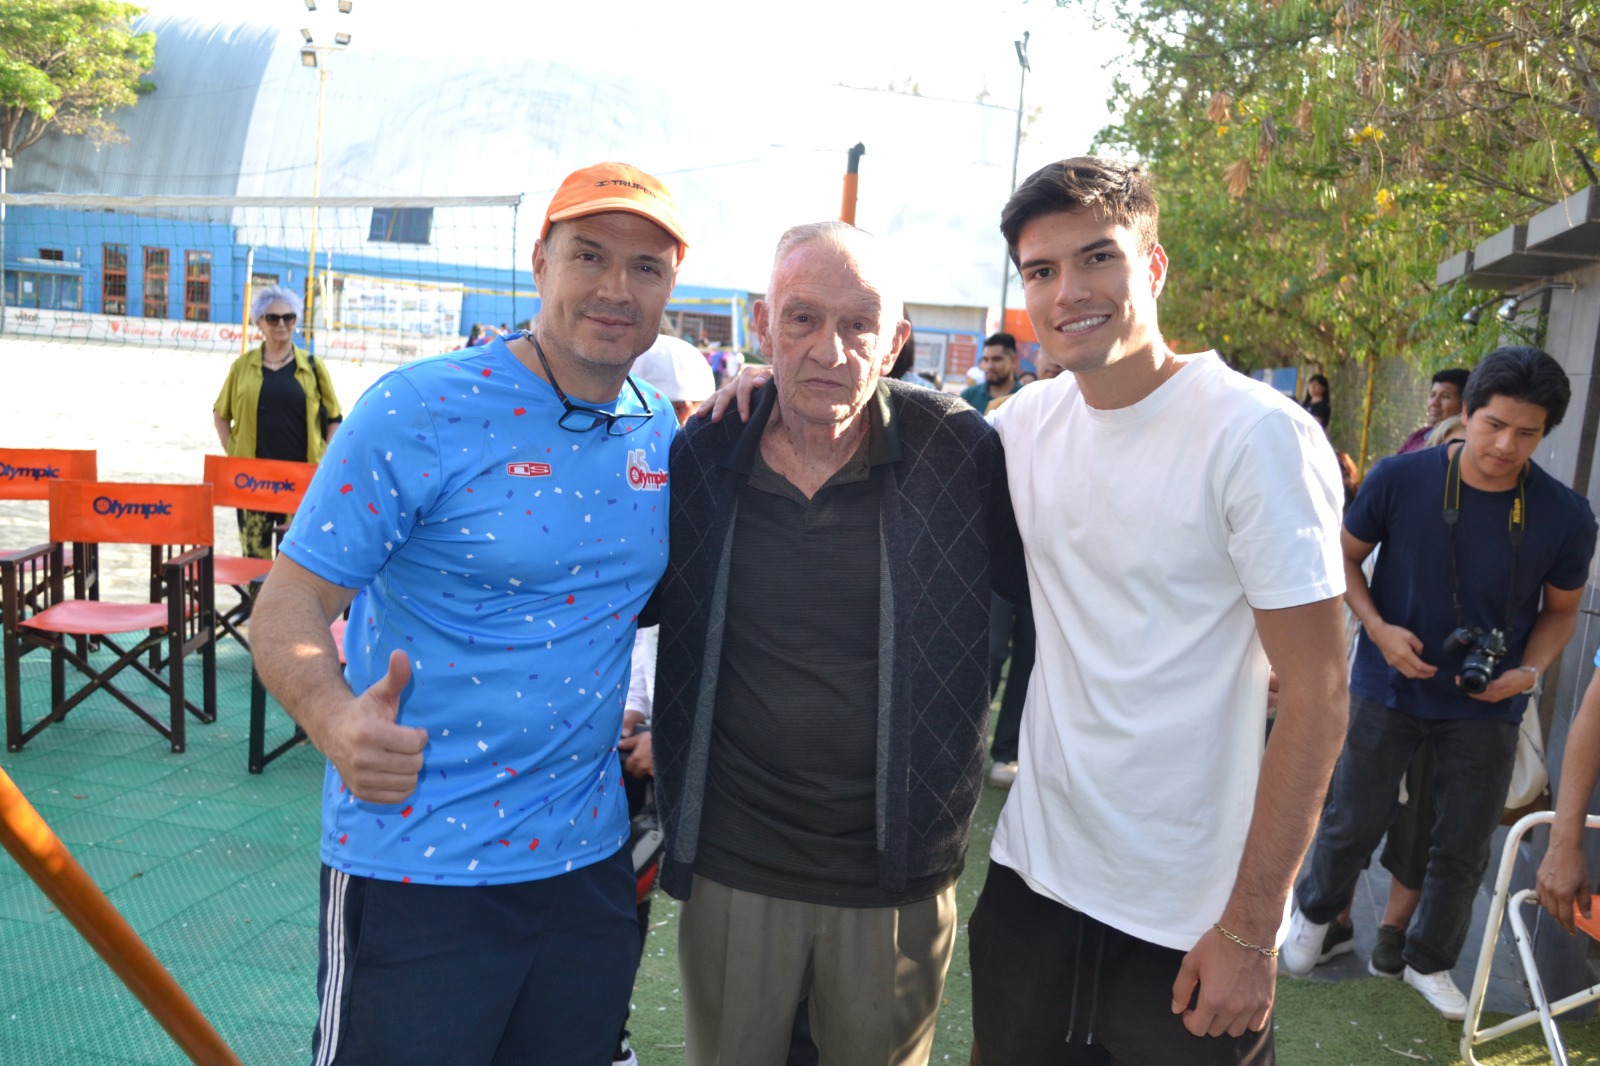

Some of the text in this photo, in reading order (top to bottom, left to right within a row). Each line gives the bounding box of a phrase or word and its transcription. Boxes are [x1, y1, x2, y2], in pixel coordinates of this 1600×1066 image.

[234, 472, 296, 495] Olympic
[92, 495, 173, 520] Olympic
[1512, 498, 1521, 524] Nikon
